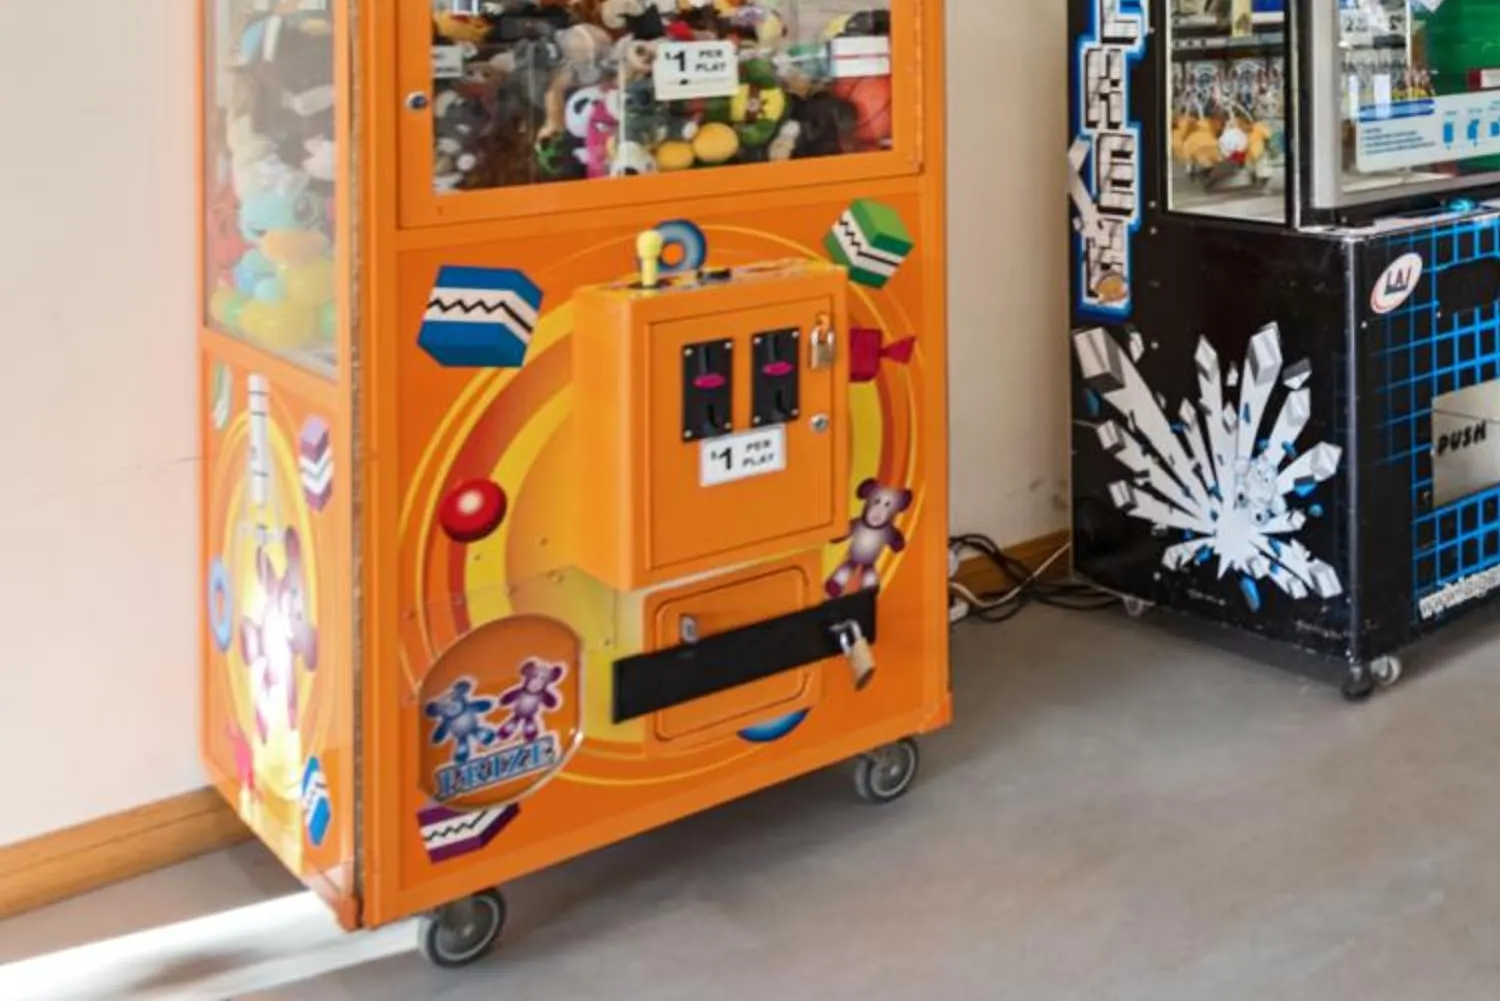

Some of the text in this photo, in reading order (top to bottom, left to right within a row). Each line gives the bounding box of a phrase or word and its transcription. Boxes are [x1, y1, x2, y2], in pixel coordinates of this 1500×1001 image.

[665, 49, 723, 73] $1 PER
[694, 61, 727, 73] PLAY
[1437, 419, 1487, 458] PUSH
[710, 439, 771, 471] $1 PER
[741, 453, 775, 469] PLAY
